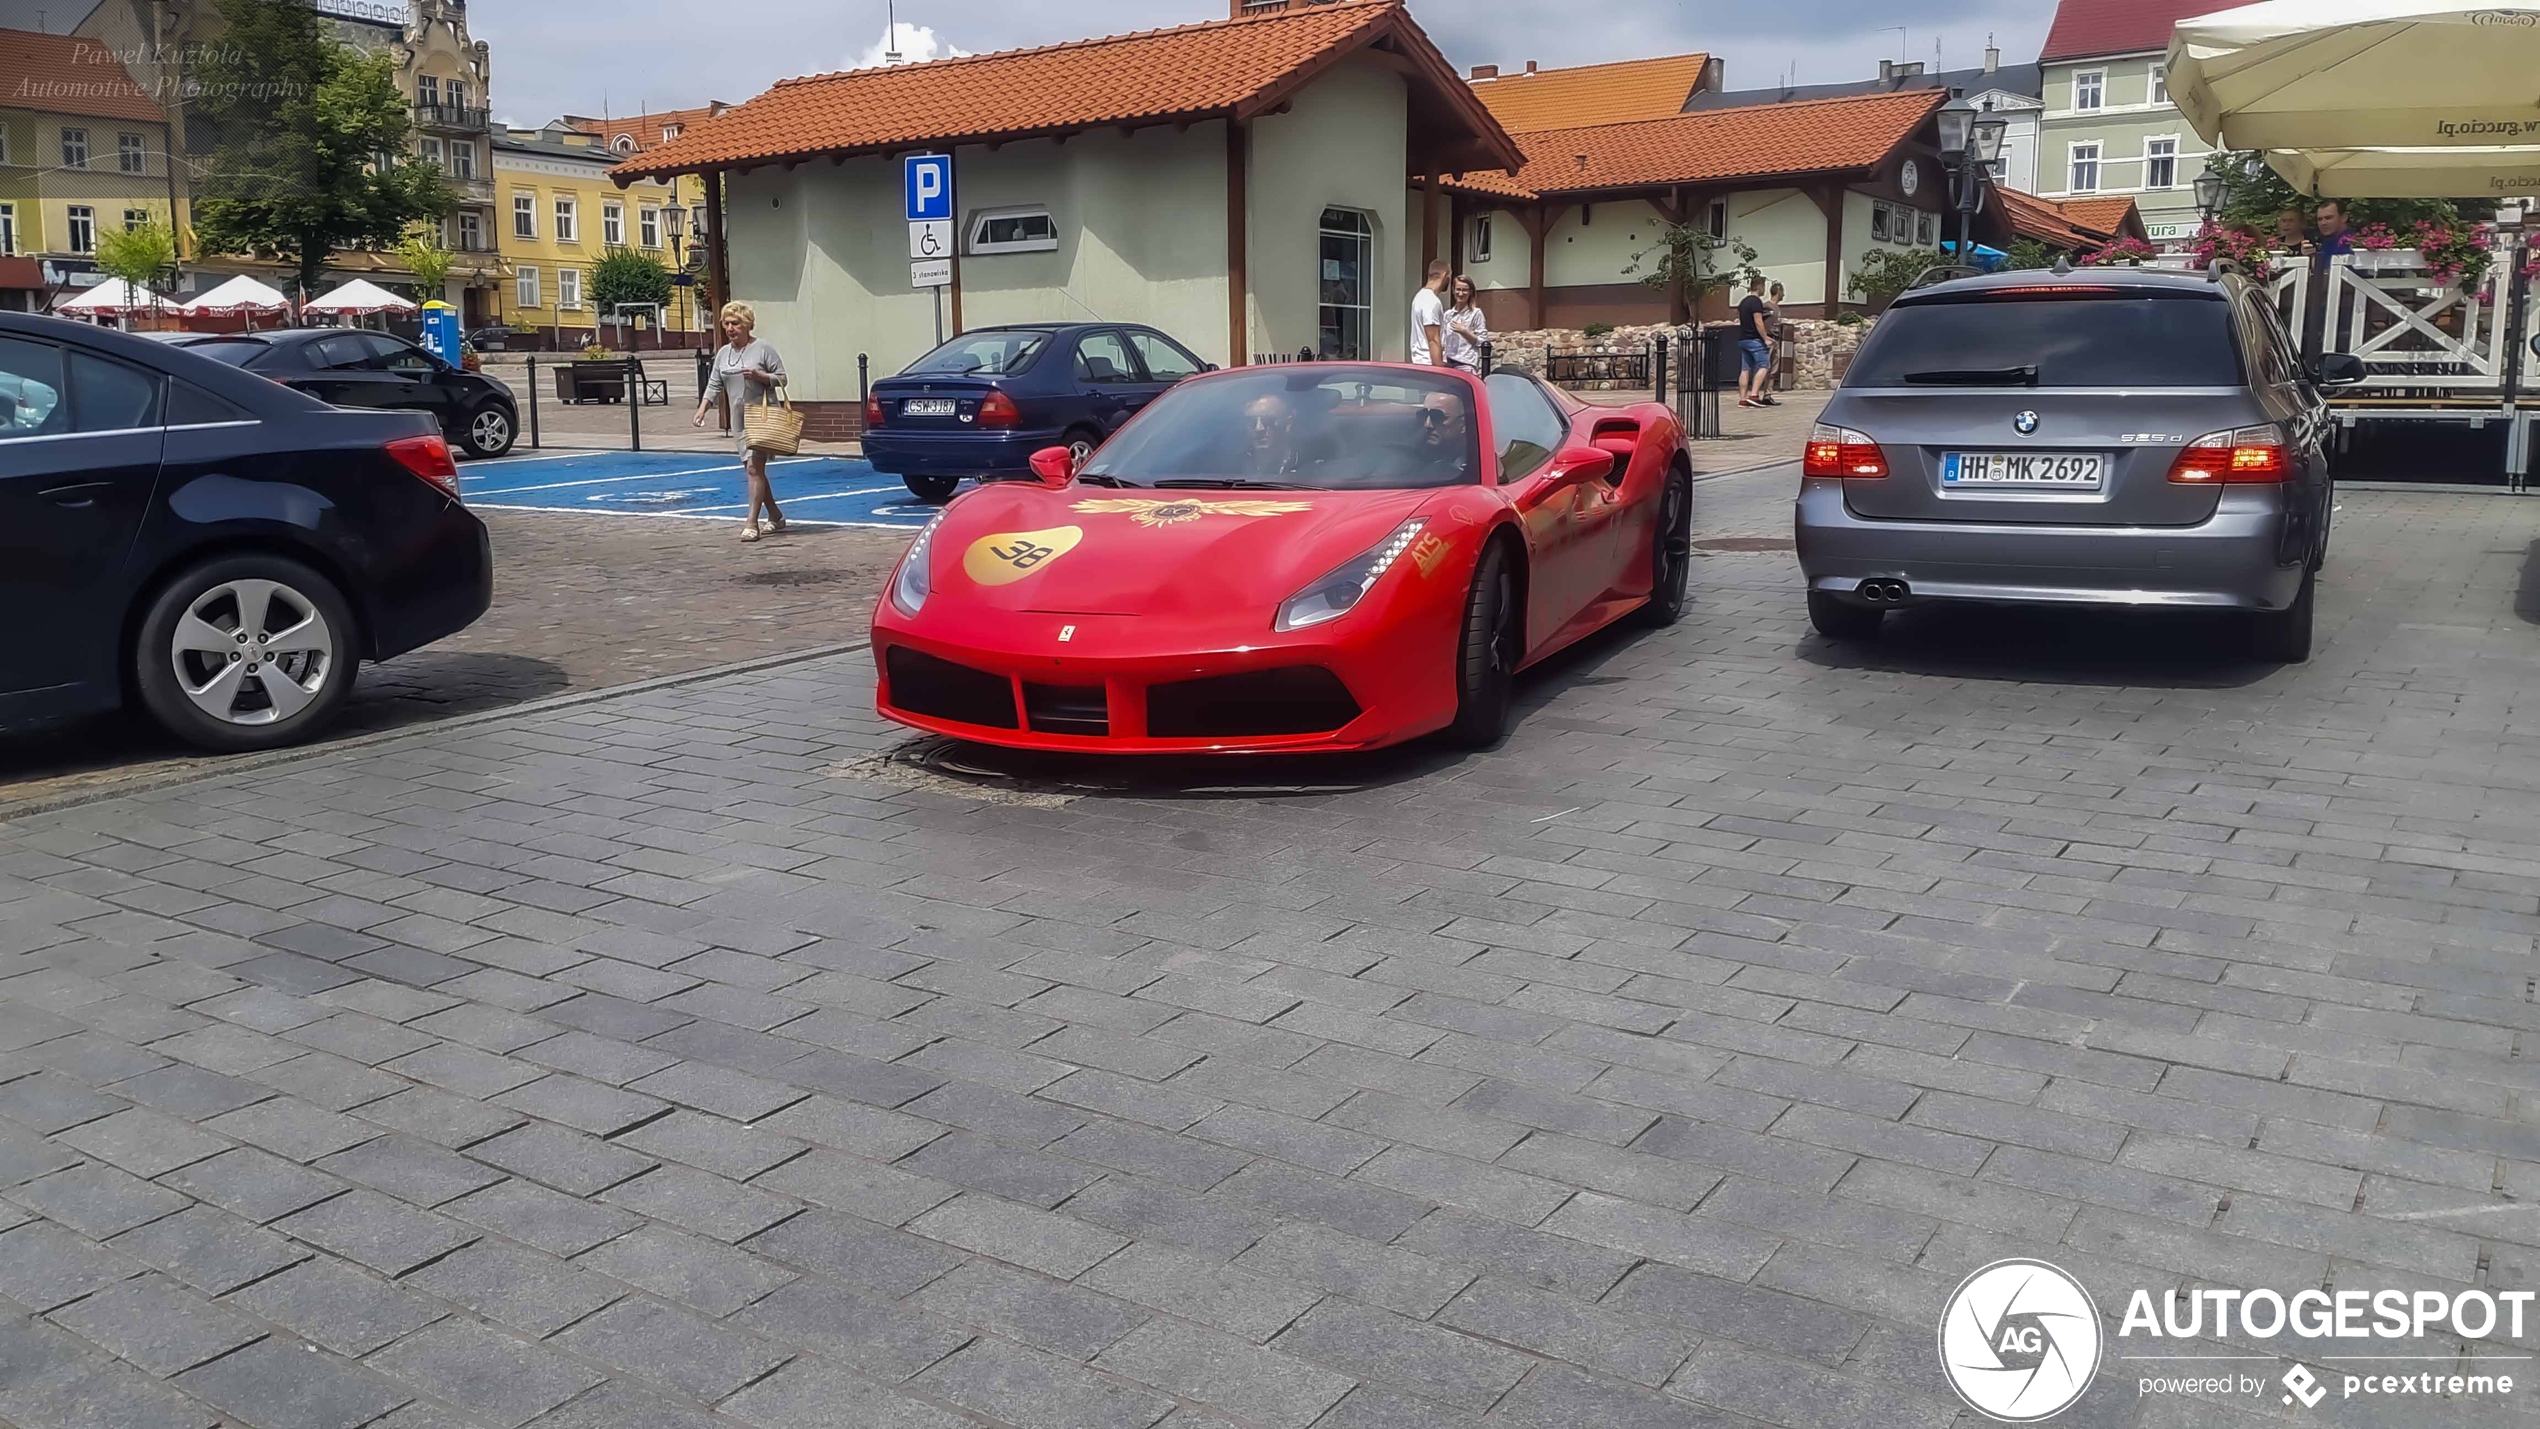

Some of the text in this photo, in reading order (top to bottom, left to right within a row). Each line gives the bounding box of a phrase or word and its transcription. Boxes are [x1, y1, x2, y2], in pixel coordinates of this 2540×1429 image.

[916, 163, 941, 212] P
[909, 400, 930, 412] CSW
[931, 400, 954, 412] 3J87
[1961, 457, 1989, 481] HH
[2006, 457, 2036, 480] MK
[2041, 457, 2099, 481] 2692
[990, 541, 1053, 568] 38
